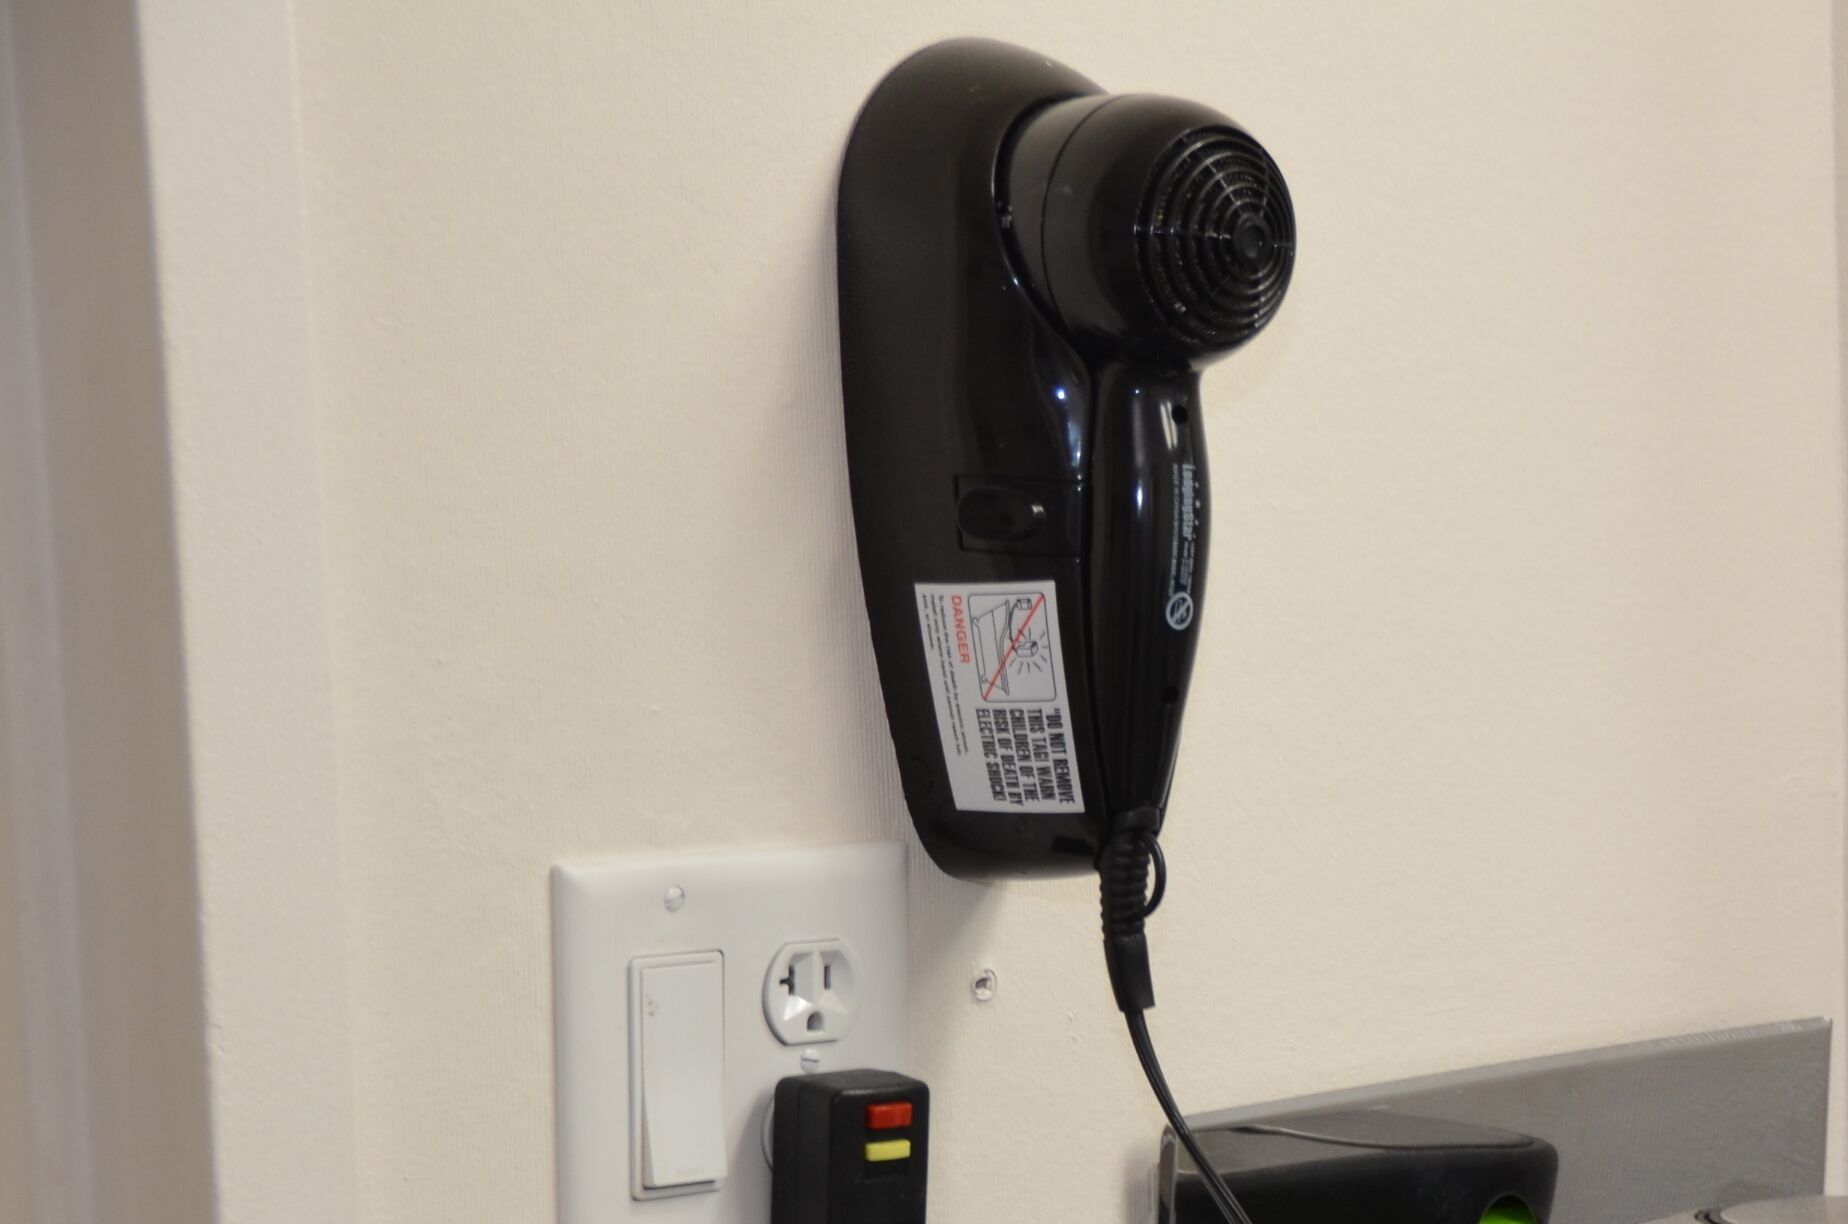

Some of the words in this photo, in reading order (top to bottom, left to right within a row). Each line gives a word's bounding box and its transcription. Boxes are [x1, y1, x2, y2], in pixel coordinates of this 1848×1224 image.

[951, 594, 970, 664] DANGER
[976, 708, 998, 759] ELECTRIC
[992, 708, 1011, 735] RISK
[1027, 708, 1045, 734] THIS
[997, 738, 1013, 752] OF
[1009, 709, 1032, 762] CHILDREN
[1048, 733, 1067, 755] NOT
[1031, 737, 1050, 763] TAG!
[986, 761, 1007, 801] SHOCK!
[1000, 755, 1021, 789] DEATH
[1019, 766, 1035, 779] OF
[1036, 766, 1057, 800] WARN
[1053, 759, 1075, 804] REMOVE
[1008, 792, 1024, 806] BY
[1022, 782, 1040, 802] THE
